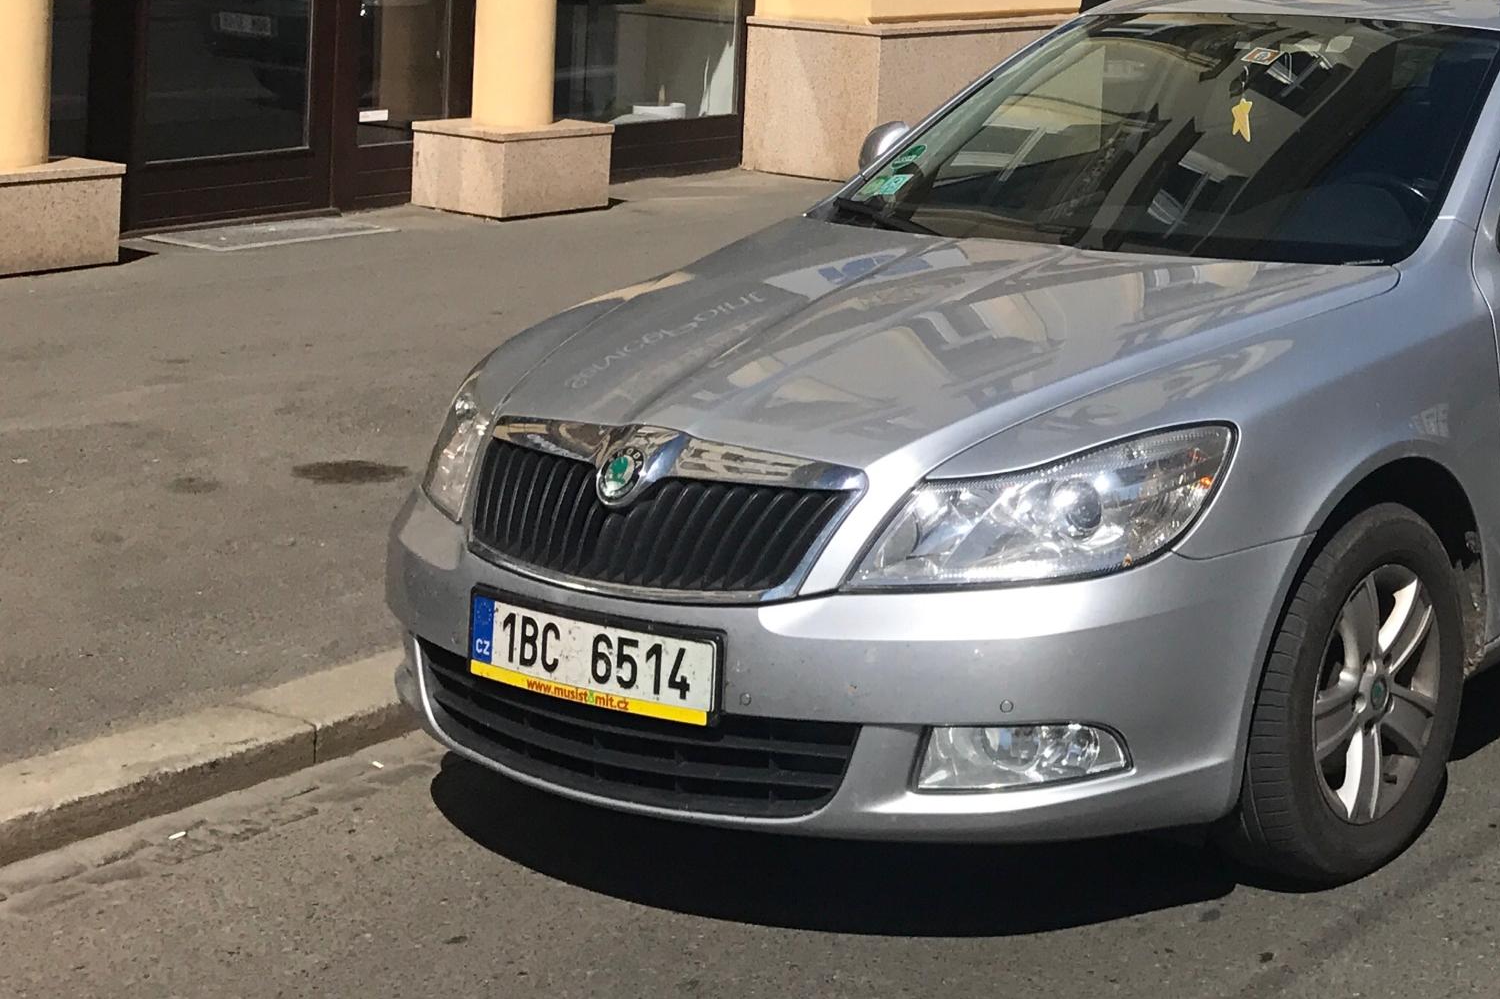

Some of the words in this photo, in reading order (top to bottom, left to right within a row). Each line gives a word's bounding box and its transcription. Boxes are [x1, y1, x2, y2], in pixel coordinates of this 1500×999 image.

[475, 638, 490, 656] CZ
[502, 612, 561, 673] 1BC
[591, 633, 690, 700] 6514
